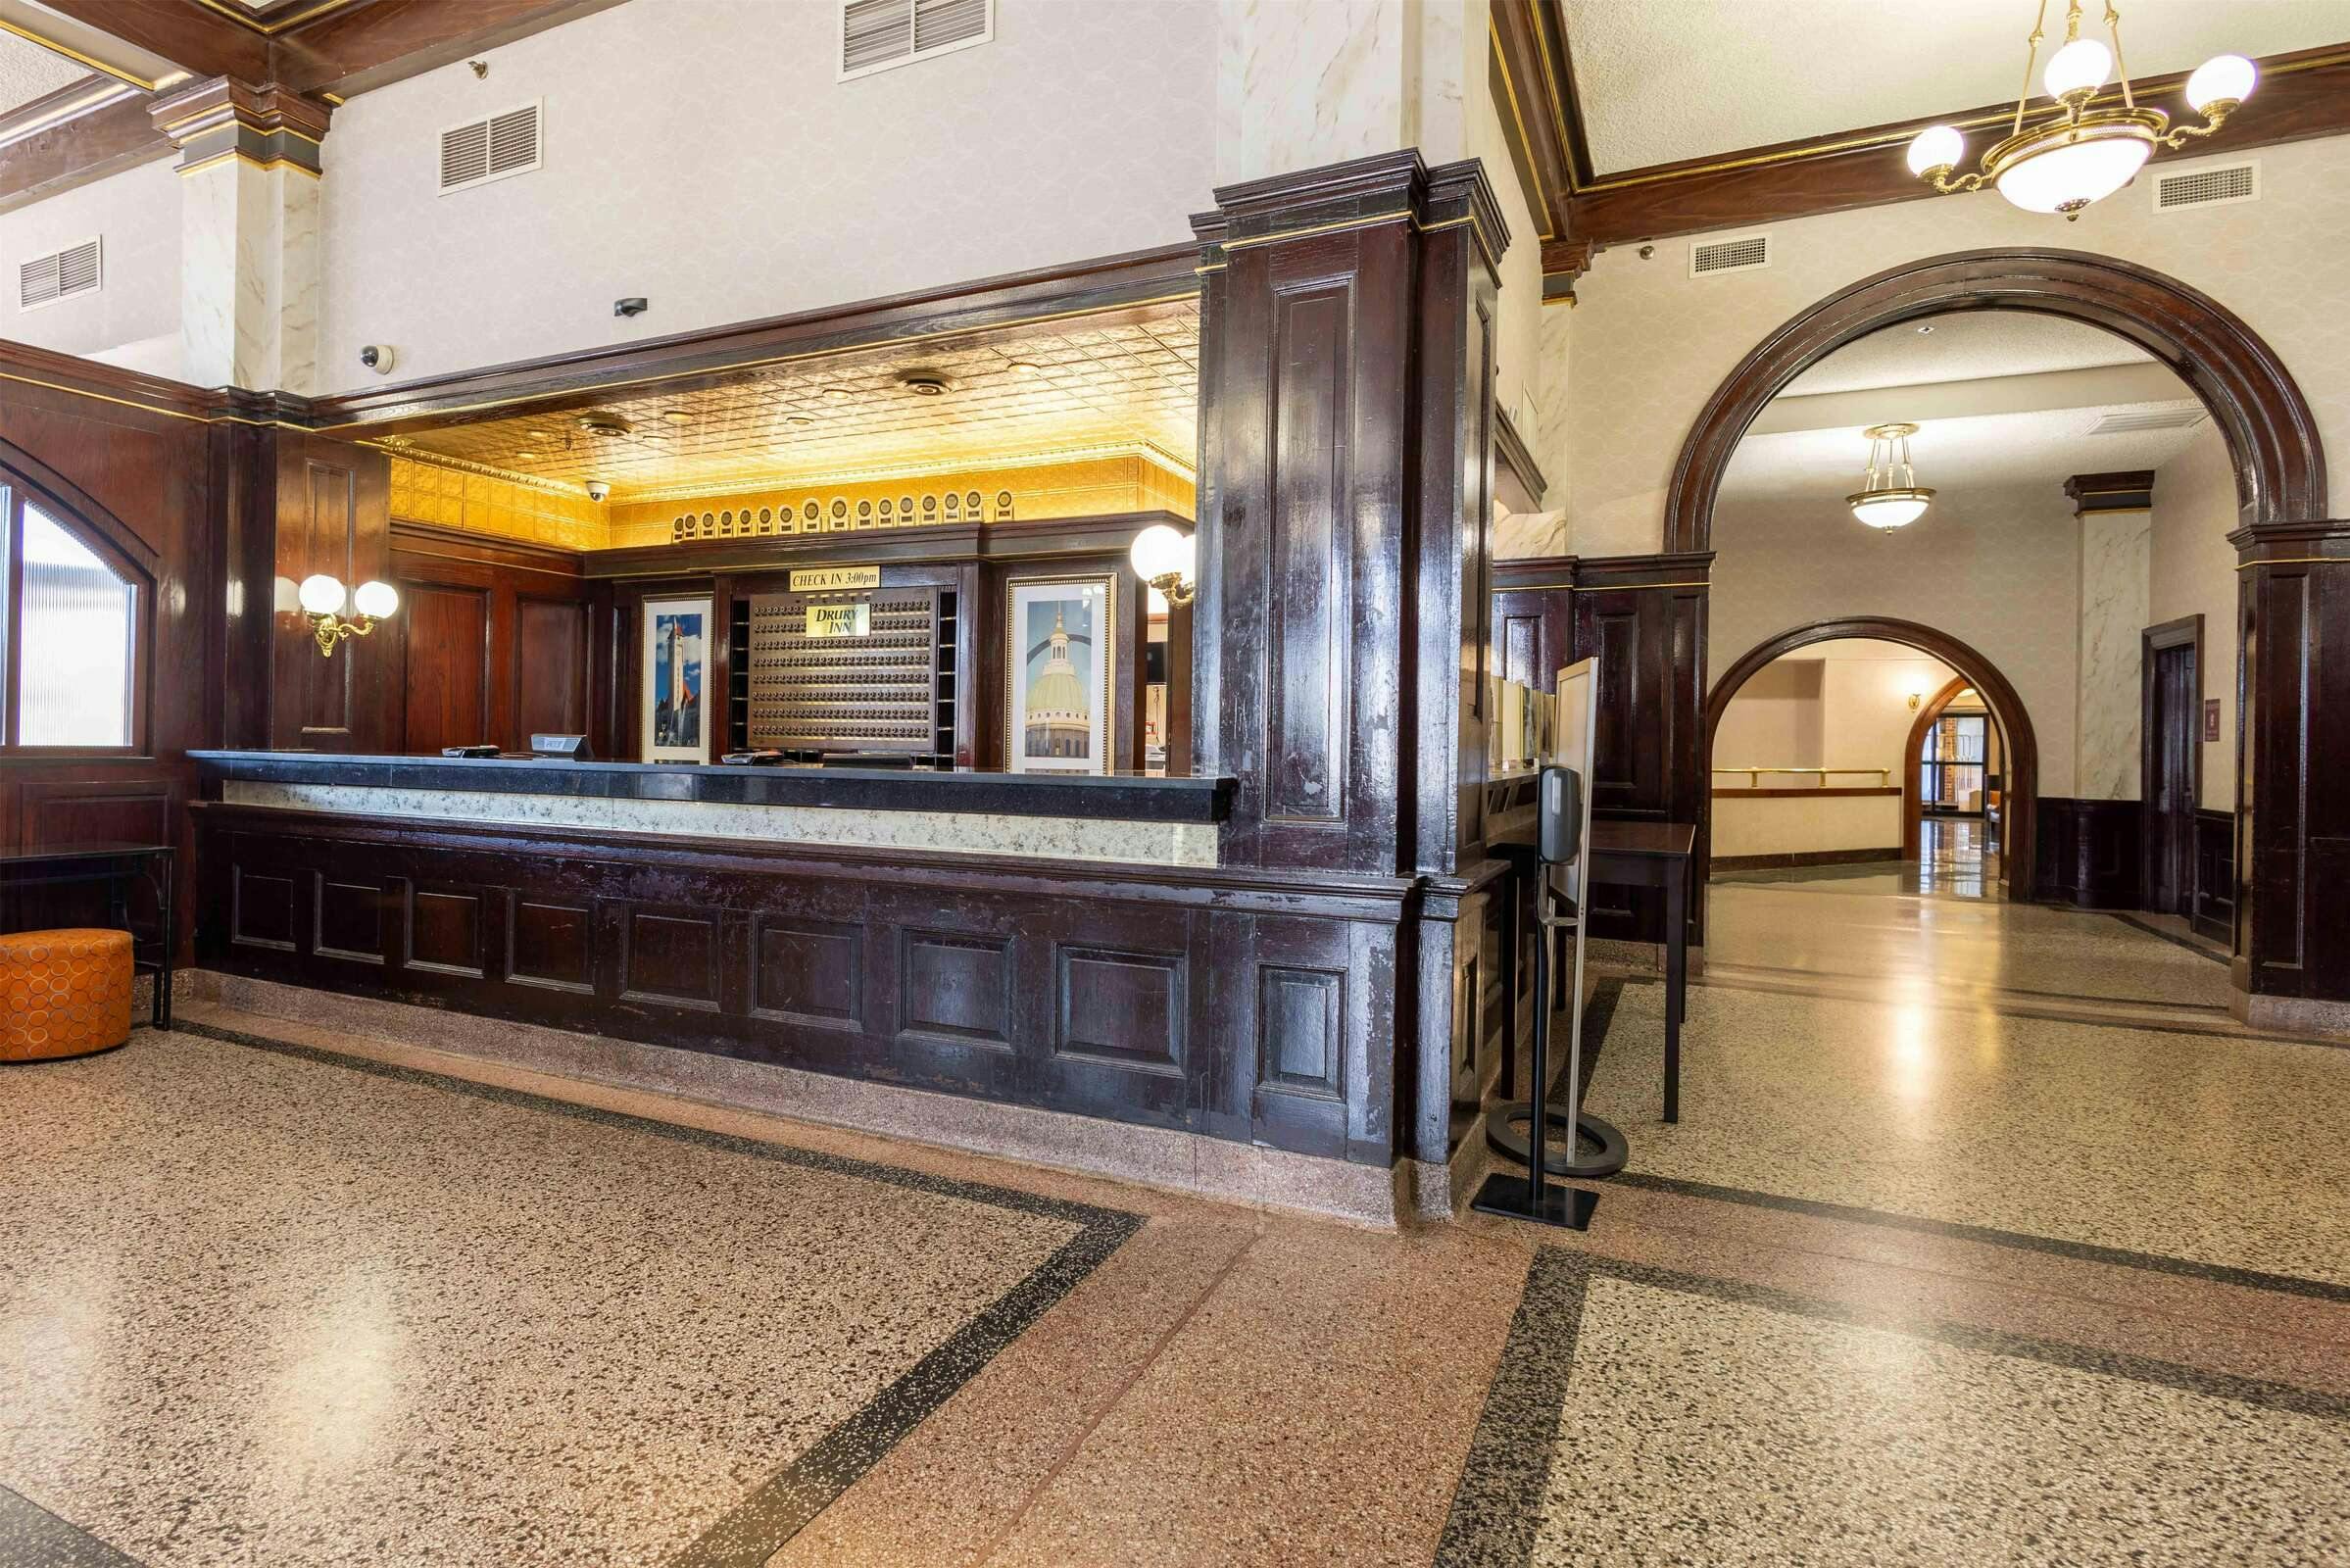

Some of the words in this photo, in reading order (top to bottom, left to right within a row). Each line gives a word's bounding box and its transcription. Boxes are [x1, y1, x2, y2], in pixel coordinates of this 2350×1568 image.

[793, 573, 827, 587] CHECK
[830, 572, 843, 585] IN
[845, 571, 877, 586] 3:00pm
[816, 609, 858, 622] DRURY
[829, 621, 852, 634] INN
